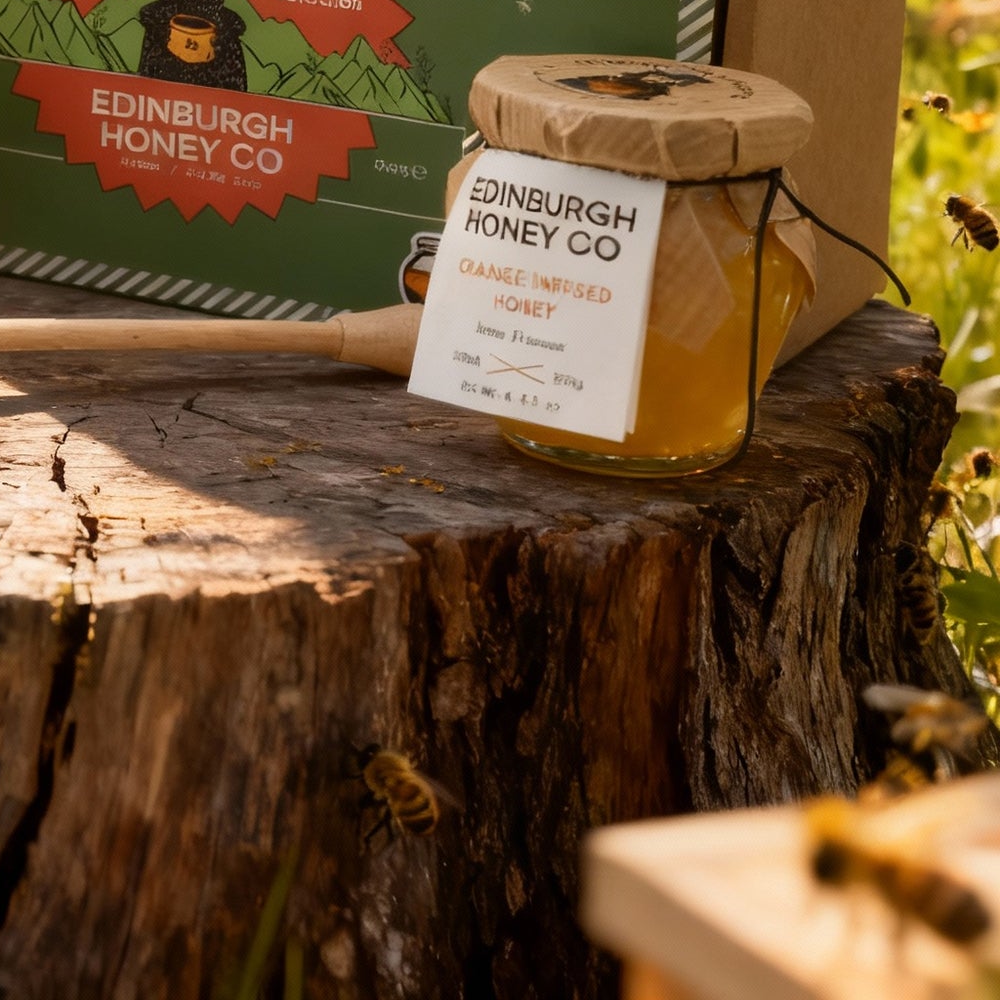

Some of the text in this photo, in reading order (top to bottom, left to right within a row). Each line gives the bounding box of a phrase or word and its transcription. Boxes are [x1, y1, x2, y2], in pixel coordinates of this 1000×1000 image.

[90, 88, 294, 145] EDINBURGH
[99, 120, 221, 166] HONEY
[230, 141, 284, 176] CO
[469, 176, 638, 233] EDINBURGH
[464, 208, 621, 262] HONEY CO
